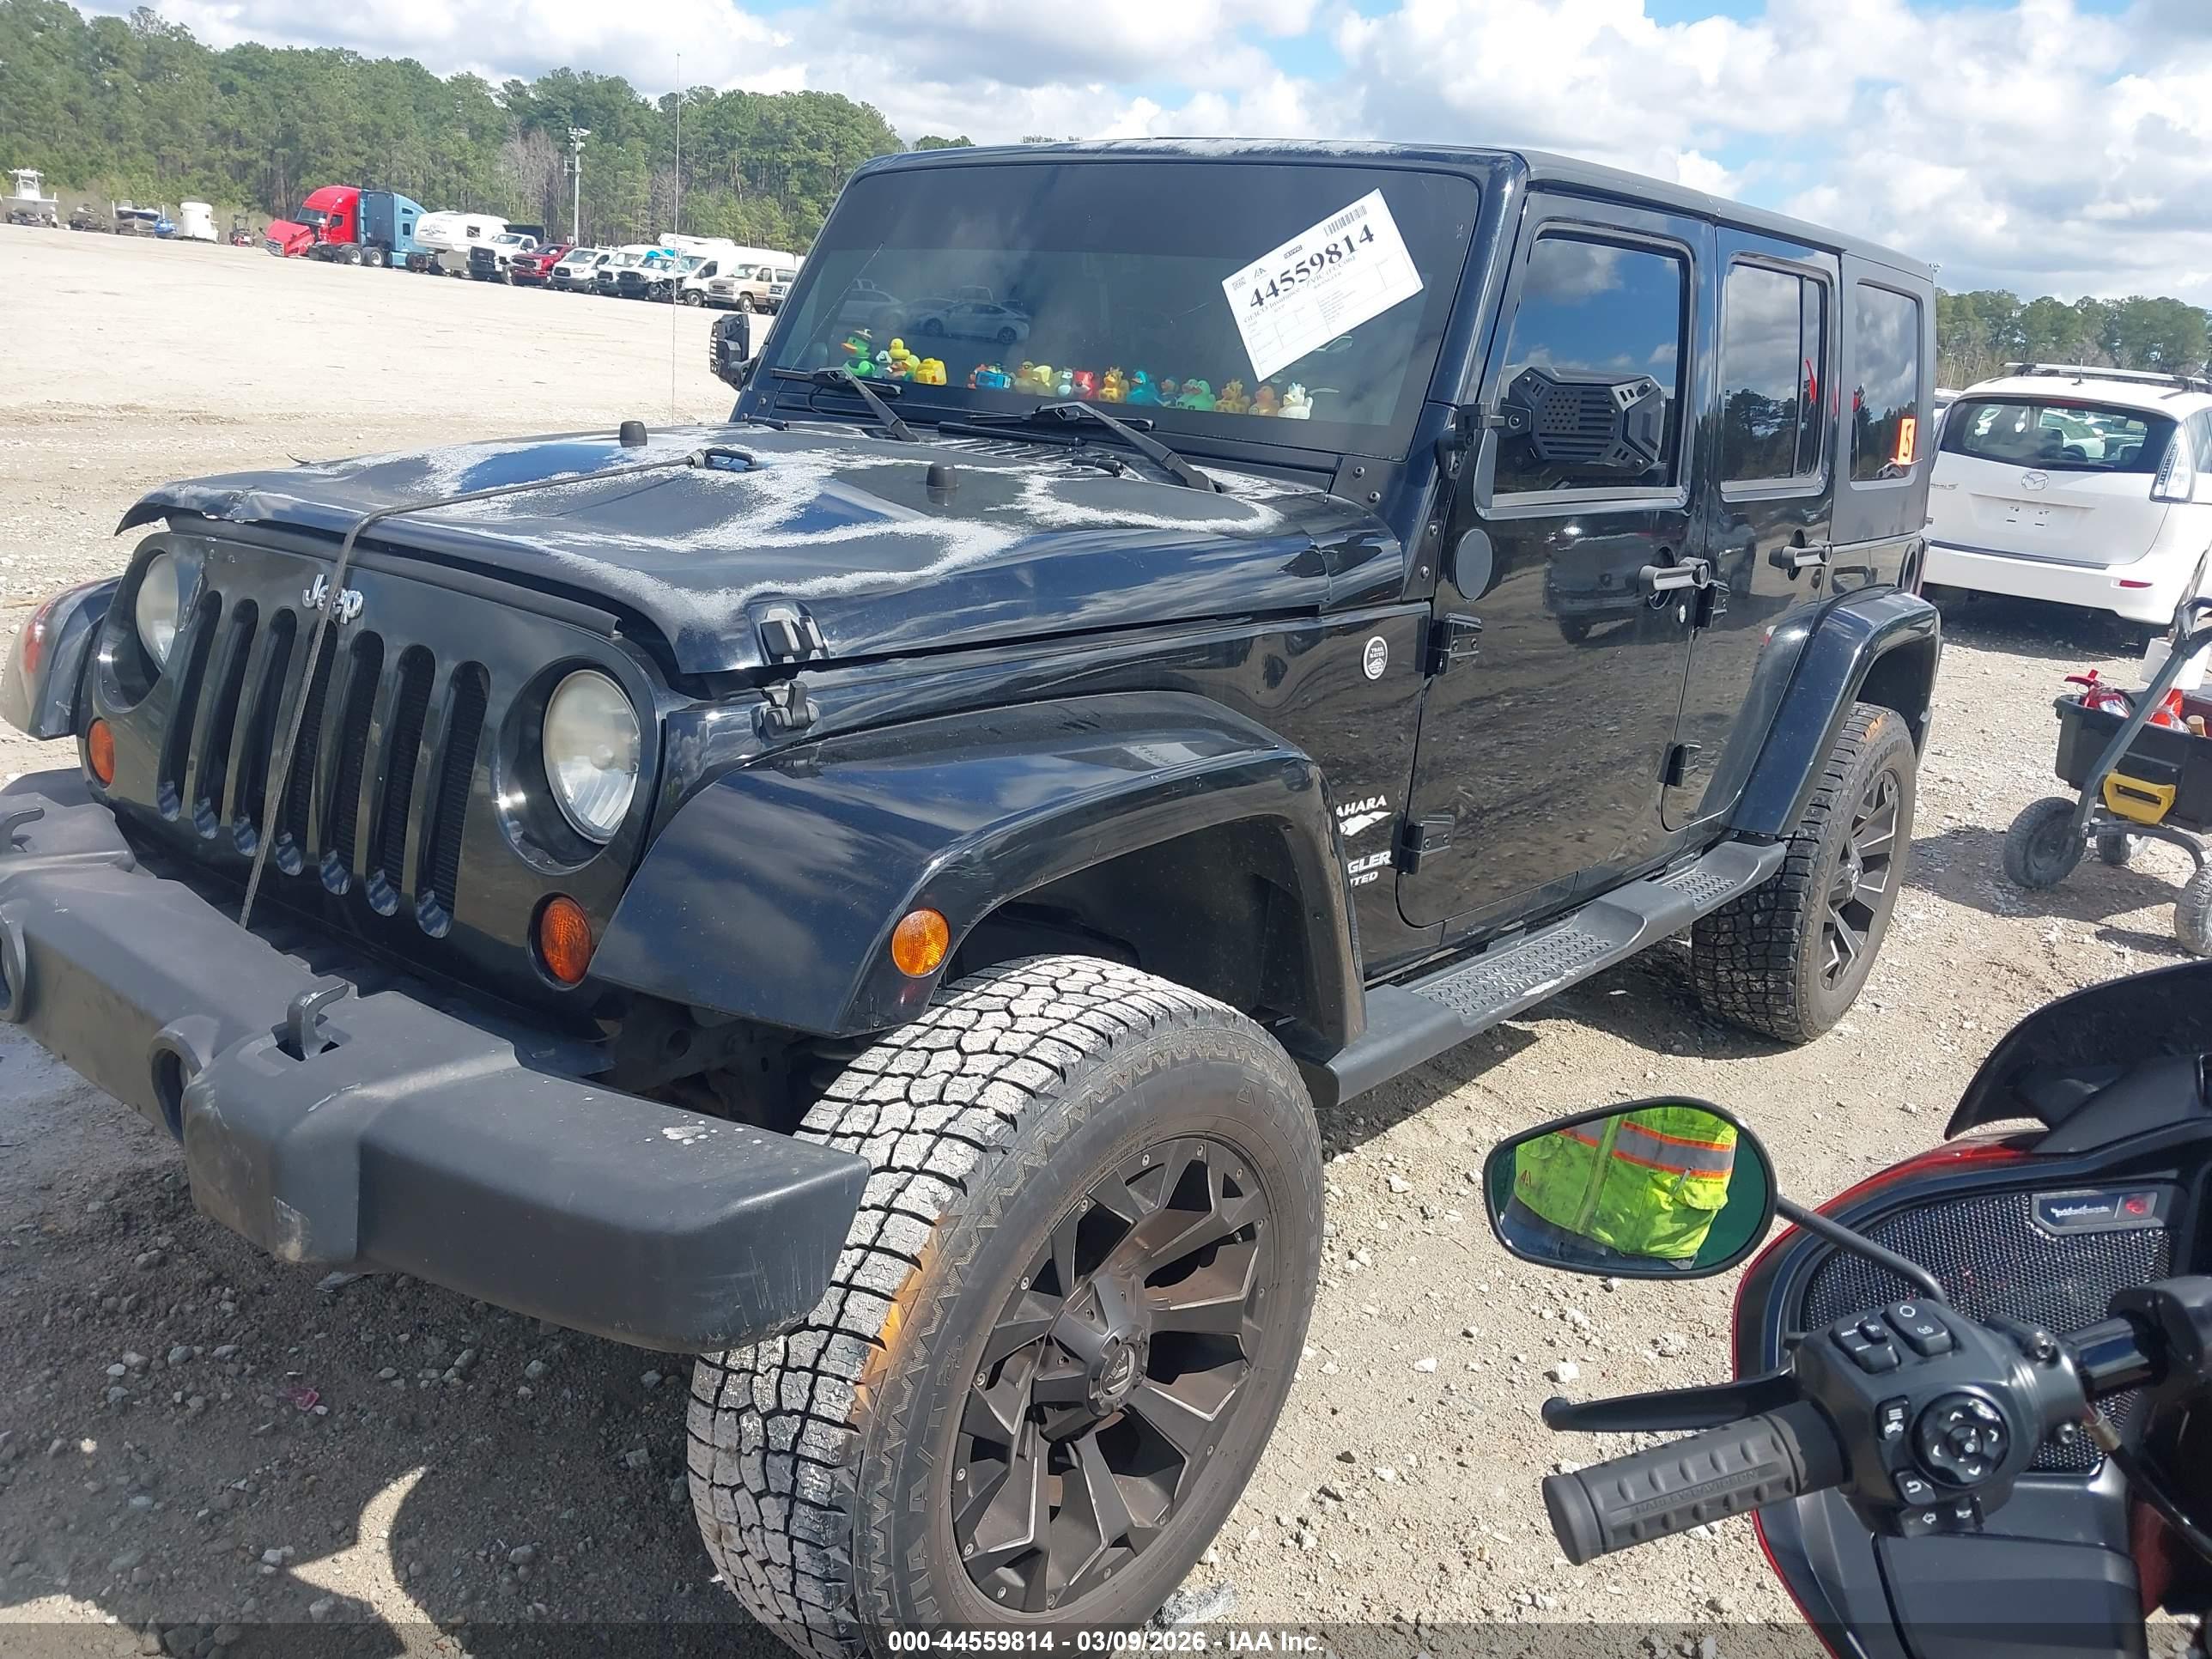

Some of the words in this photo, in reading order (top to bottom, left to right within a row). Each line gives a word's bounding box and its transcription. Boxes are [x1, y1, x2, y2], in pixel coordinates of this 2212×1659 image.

[1249, 223, 1375, 308] 44559814
[1243, 306, 1268, 324] GEICO
[1269, 288, 1301, 309] Insurance
[302, 574, 363, 625] Jeep
[1336, 794, 1388, 817] AHARA
[1347, 850, 1393, 874] GLER
